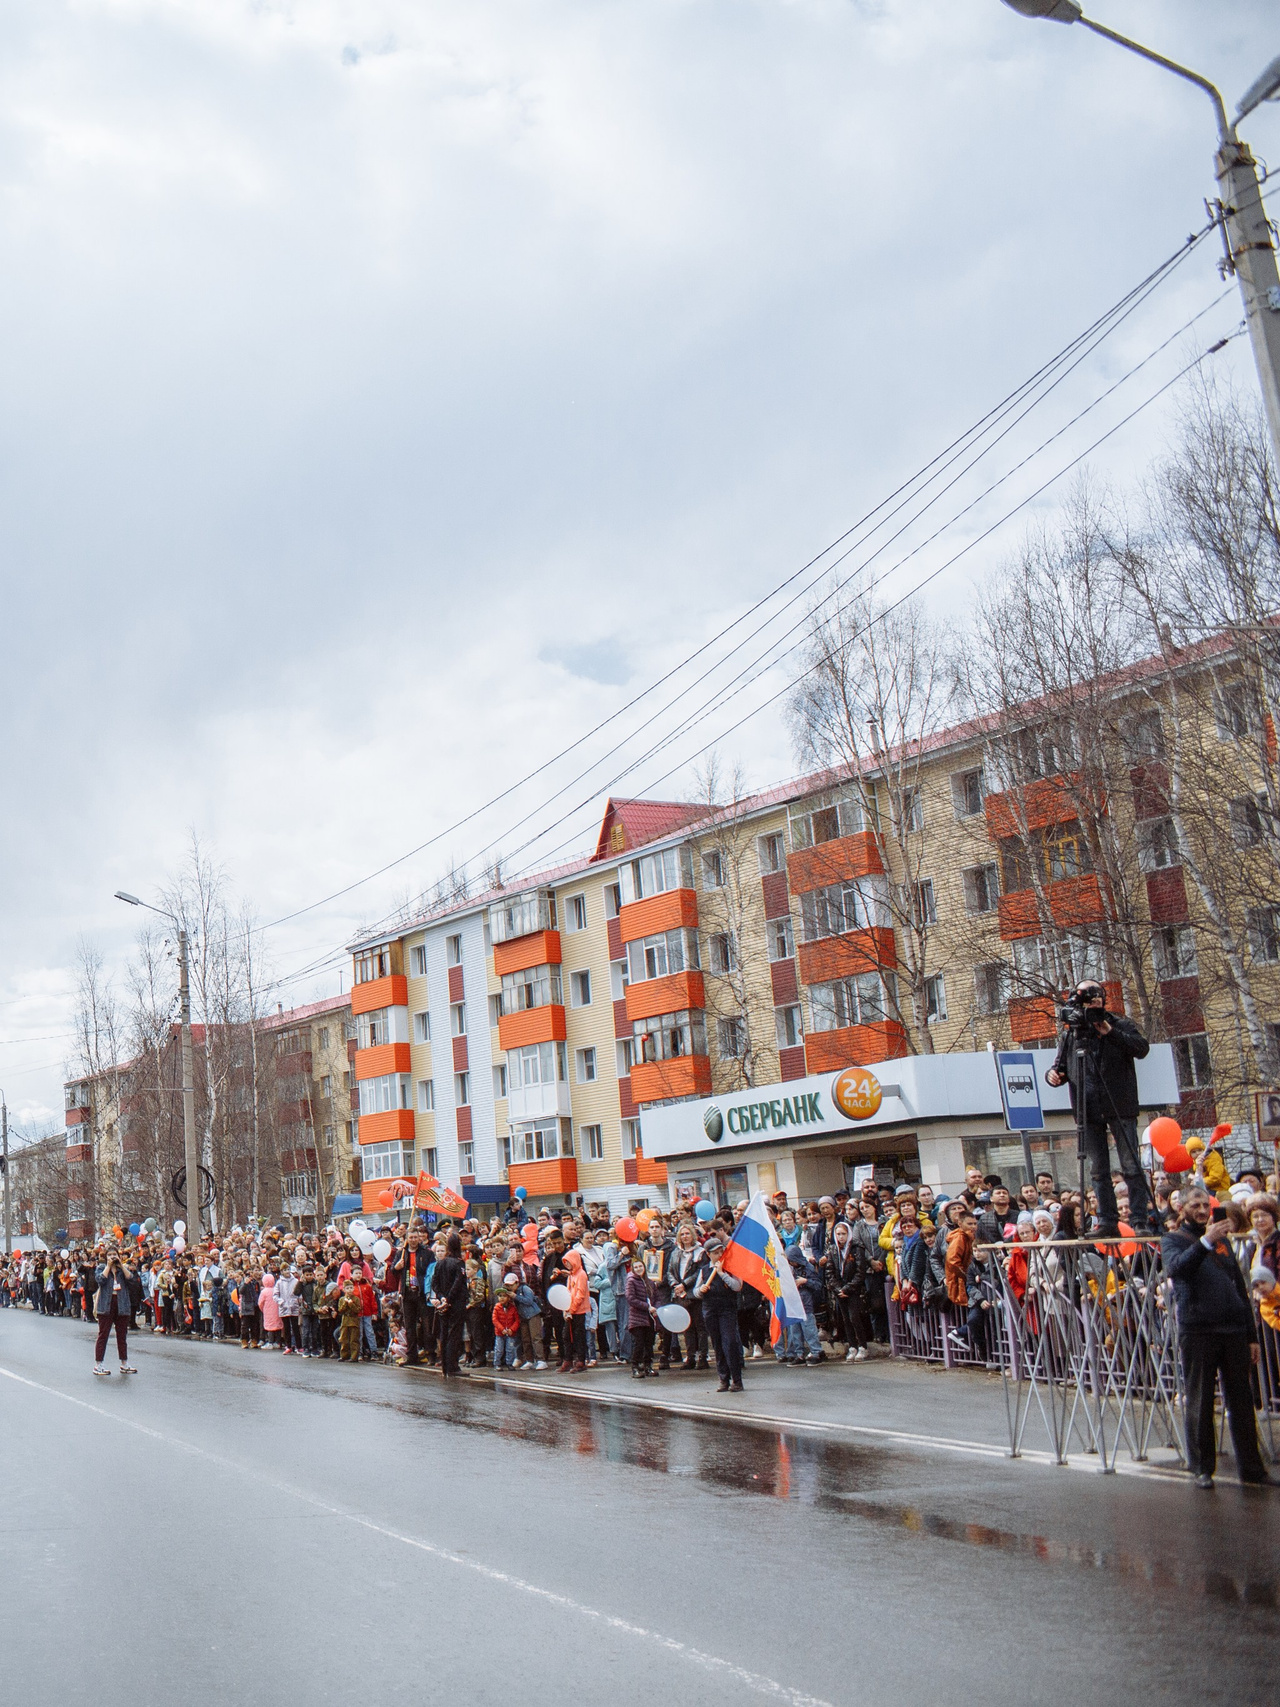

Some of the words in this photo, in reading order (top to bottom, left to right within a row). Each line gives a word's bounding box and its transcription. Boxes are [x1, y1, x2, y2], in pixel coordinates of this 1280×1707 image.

[842, 1078, 872, 1098] 24
[727, 1091, 825, 1134] СБЕРБАНК
[843, 1099, 872, 1108] ЧАСА
